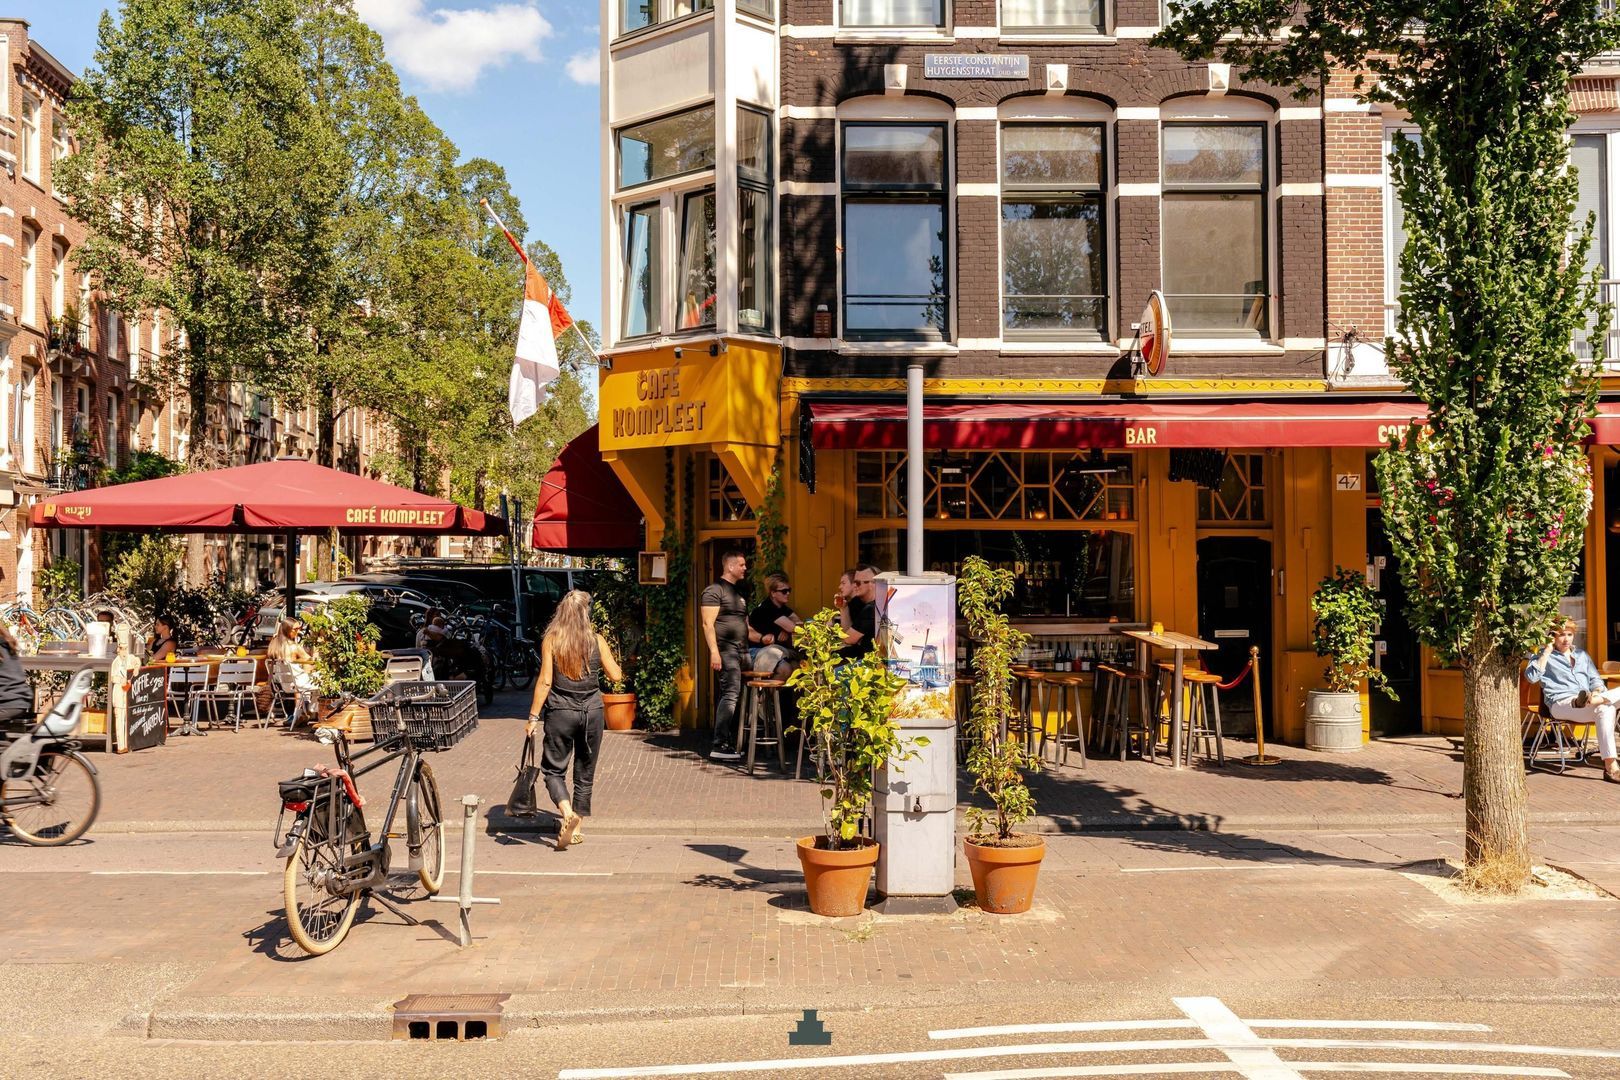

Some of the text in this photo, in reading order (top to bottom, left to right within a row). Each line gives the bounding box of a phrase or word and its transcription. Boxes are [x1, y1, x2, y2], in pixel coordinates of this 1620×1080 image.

[934, 56, 1020, 67] EERSTE CONSTANTIJN
[927, 67, 995, 75] HUYGENSSTRAAT
[636, 362, 681, 401] CAFÉ
[613, 401, 706, 438] KOMPLEET
[1125, 427, 1157, 444] BAR
[1338, 475, 1359, 489] 47
[346, 505, 445, 525] CAFÉ KOMPLEET
